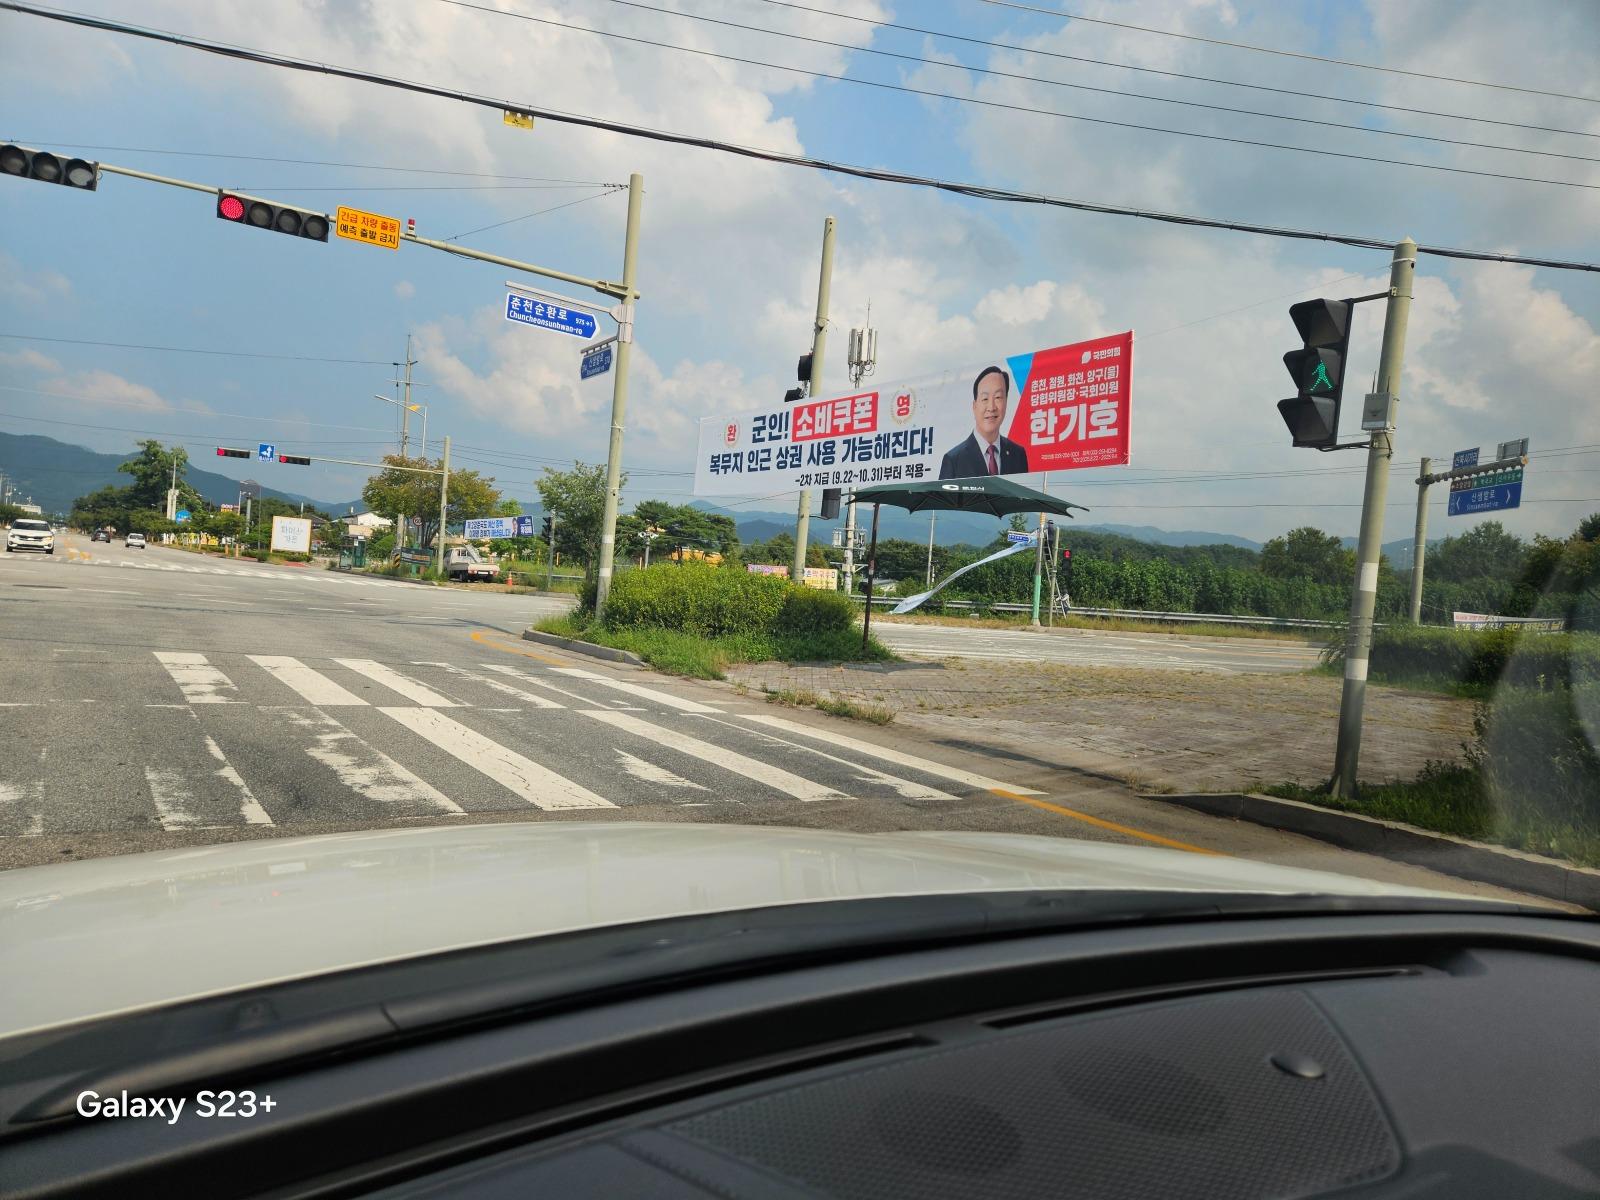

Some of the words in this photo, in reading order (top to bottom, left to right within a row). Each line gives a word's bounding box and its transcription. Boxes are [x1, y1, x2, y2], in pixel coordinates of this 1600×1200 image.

[340, 223, 357, 236] 예측
[360, 228, 377, 241] 출발
[380, 232, 396, 245] 금지
[341, 211, 358, 224] 긴급
[361, 216, 378, 229] 차량
[380, 221, 397, 233] 출동
[510, 296, 568, 321] 춘천순환로
[509, 309, 583, 335] Chuncheonsunhwan-ro
[1092, 346, 1121, 361] 국민의힘
[1031, 377, 1049, 393] 춘천,
[1049, 375, 1067, 390] 철원,
[1067, 371, 1086, 387] 화천,
[1087, 364, 1120, 384] 양구(을)
[896, 394, 911, 416] 영
[751, 411, 790, 444] 군인!
[795, 395, 874, 438] 소비쿠폰
[1030, 399, 1119, 446] 한기호
[709, 451, 744, 475] 복무지
[747, 447, 772, 472] 인근
[776, 444, 803, 469] 상권
[807, 438, 836, 466] 사용
[841, 426, 935, 462] 가능해진다!
[814, 471, 830, 485] 지급
